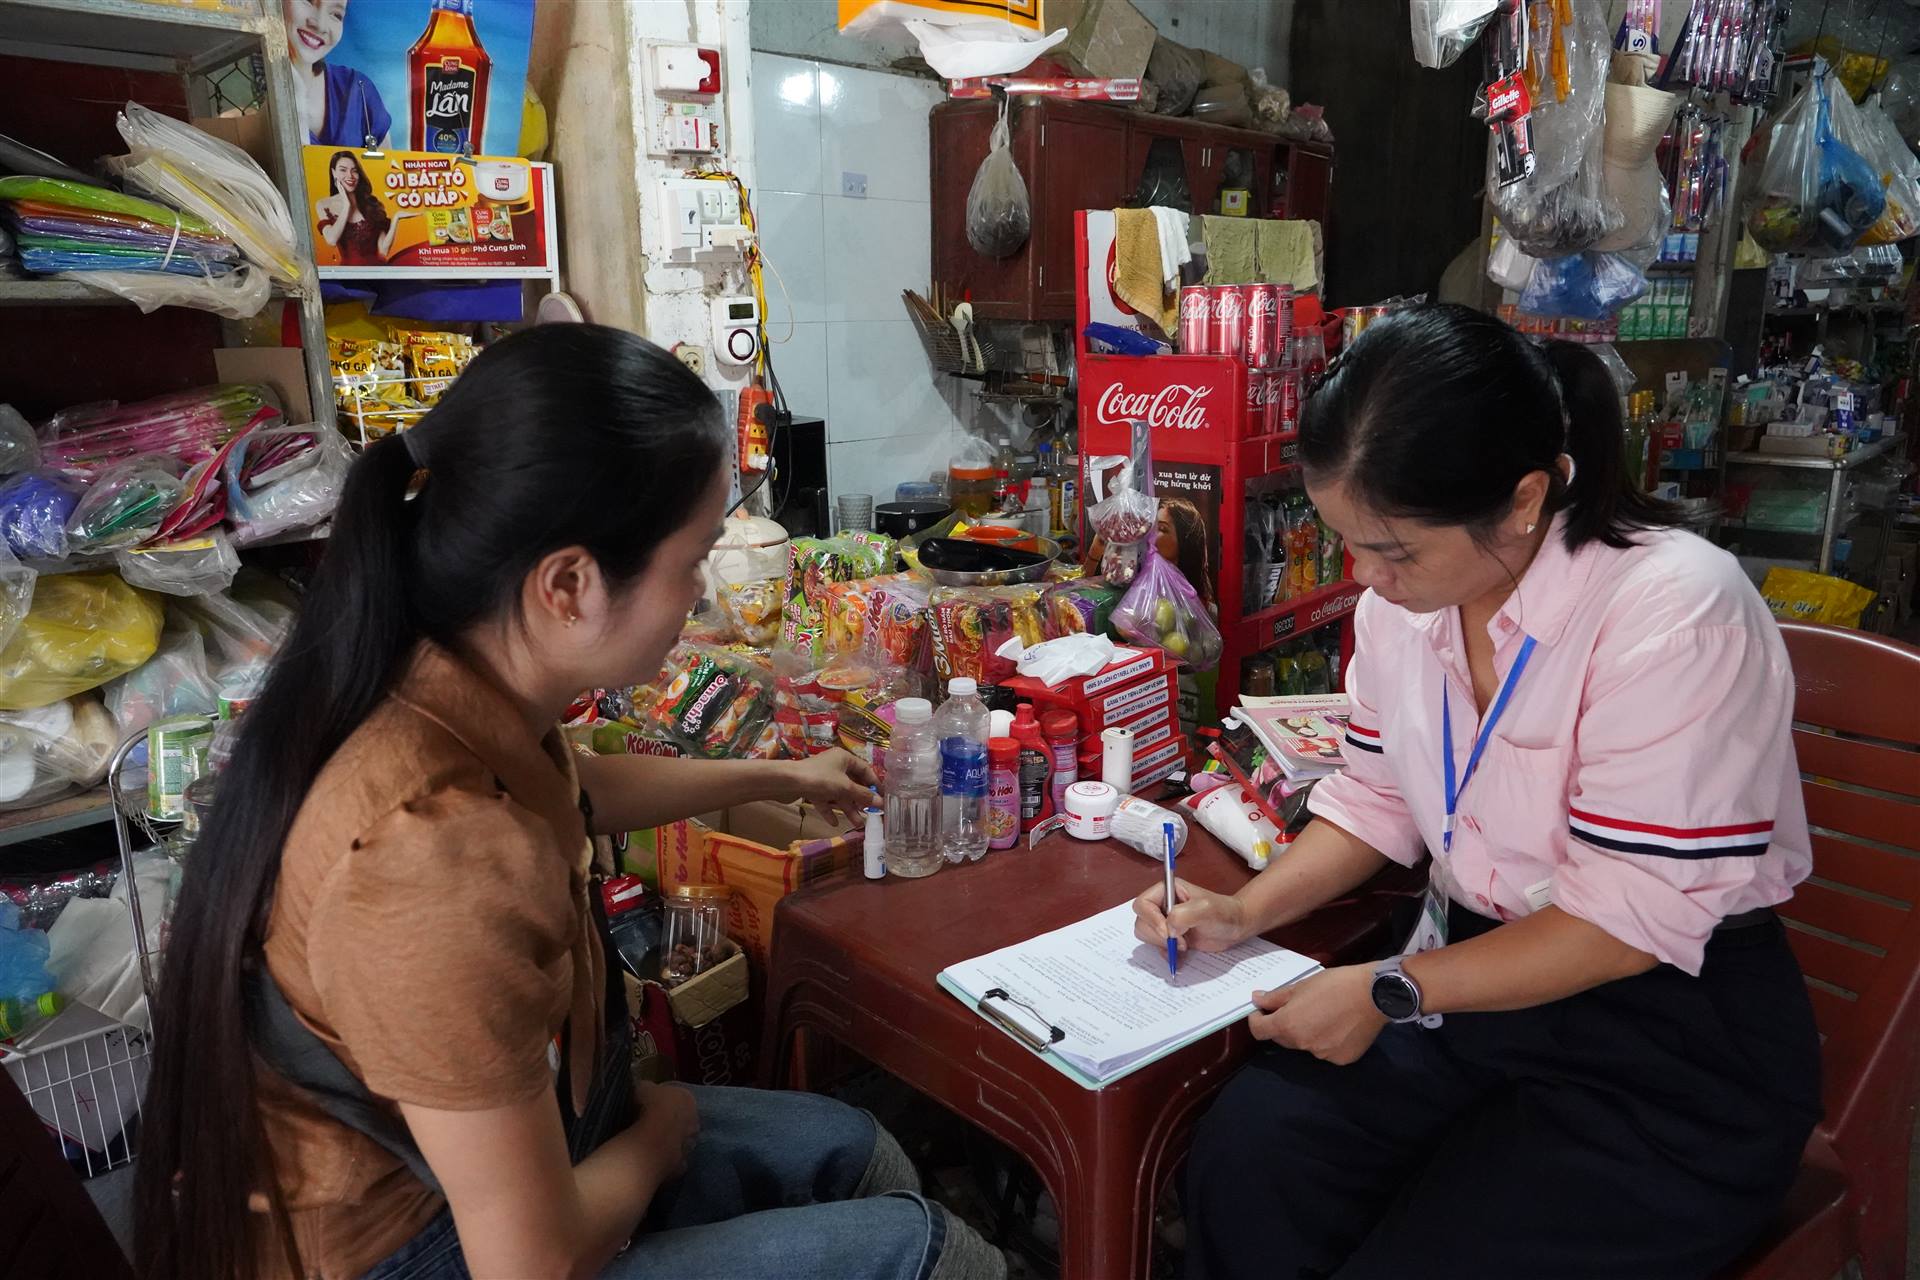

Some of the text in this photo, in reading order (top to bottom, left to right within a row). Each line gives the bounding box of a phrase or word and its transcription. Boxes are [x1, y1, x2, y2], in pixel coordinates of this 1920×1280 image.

[431, 80, 469, 95] Madame
[1492, 90, 1520, 109] Gillette
[428, 160, 448, 169] NGAY
[386, 168, 465, 188] 01 BÁT TÔ
[397, 185, 459, 207] CÓ NẮP
[418, 247, 432, 255] Khi
[451, 247, 460, 255] 10
[489, 244, 508, 253] Cung
[353, 360, 368, 372] GÀ
[1097, 382, 1214, 430] Coca-Cola
[1158, 472, 1173, 480] xua
[1174, 471, 1187, 480] tan
[685, 673, 728, 724] Omachi
